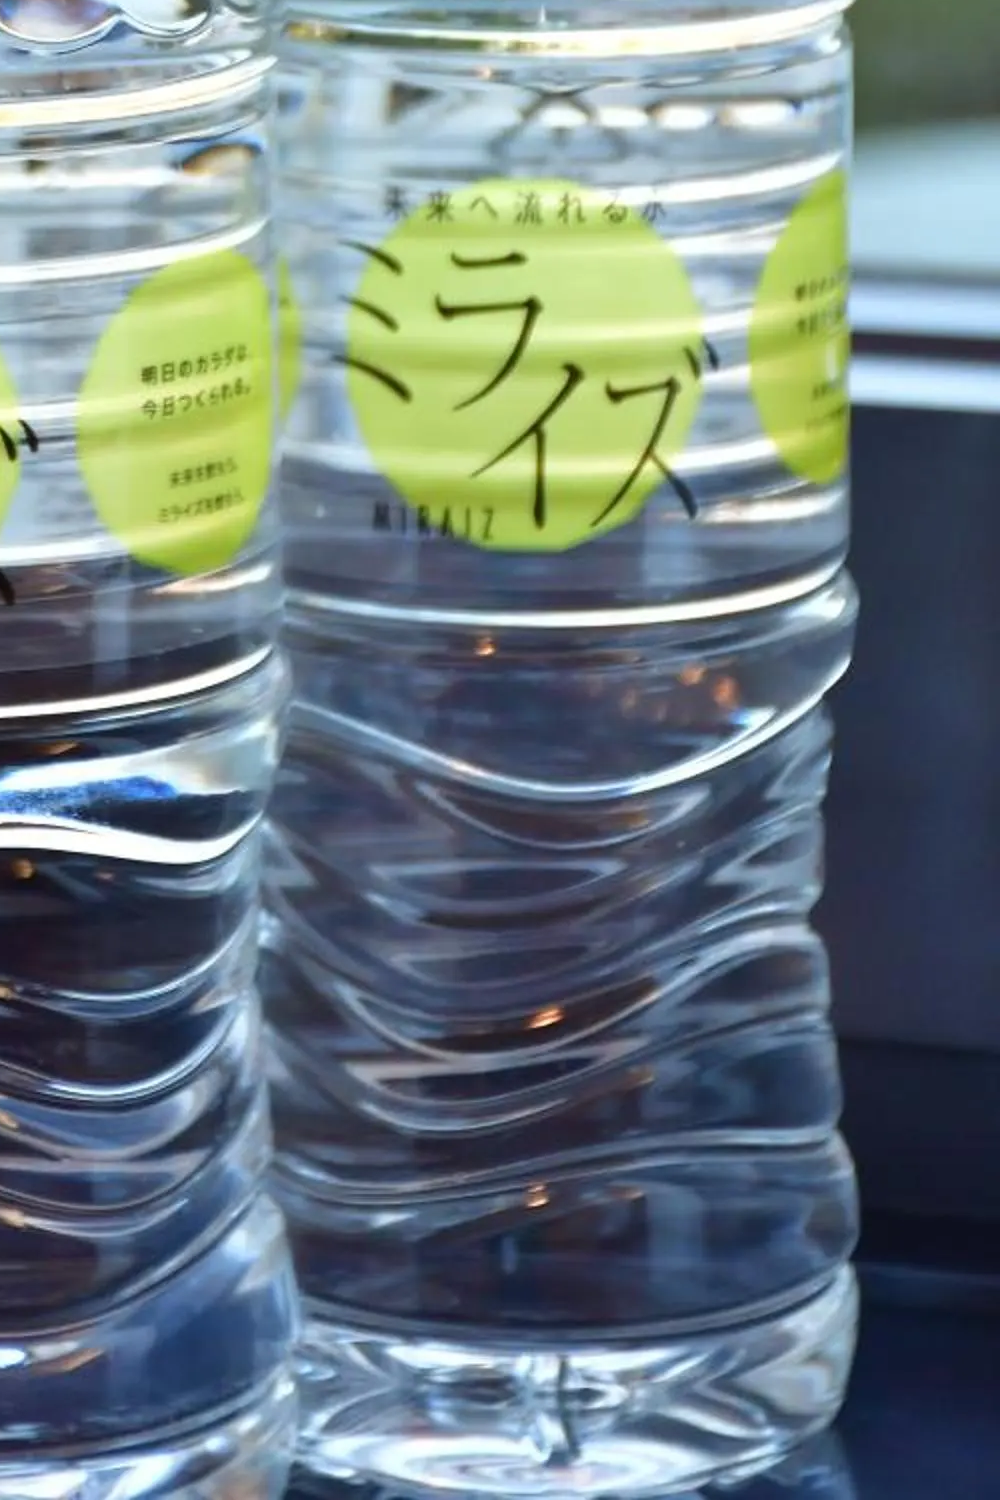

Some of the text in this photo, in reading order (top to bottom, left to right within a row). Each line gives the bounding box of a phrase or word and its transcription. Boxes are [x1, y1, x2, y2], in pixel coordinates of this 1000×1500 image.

[331, 238, 719, 529] ミライズ
[373, 501, 494, 541] MIRAIZ
